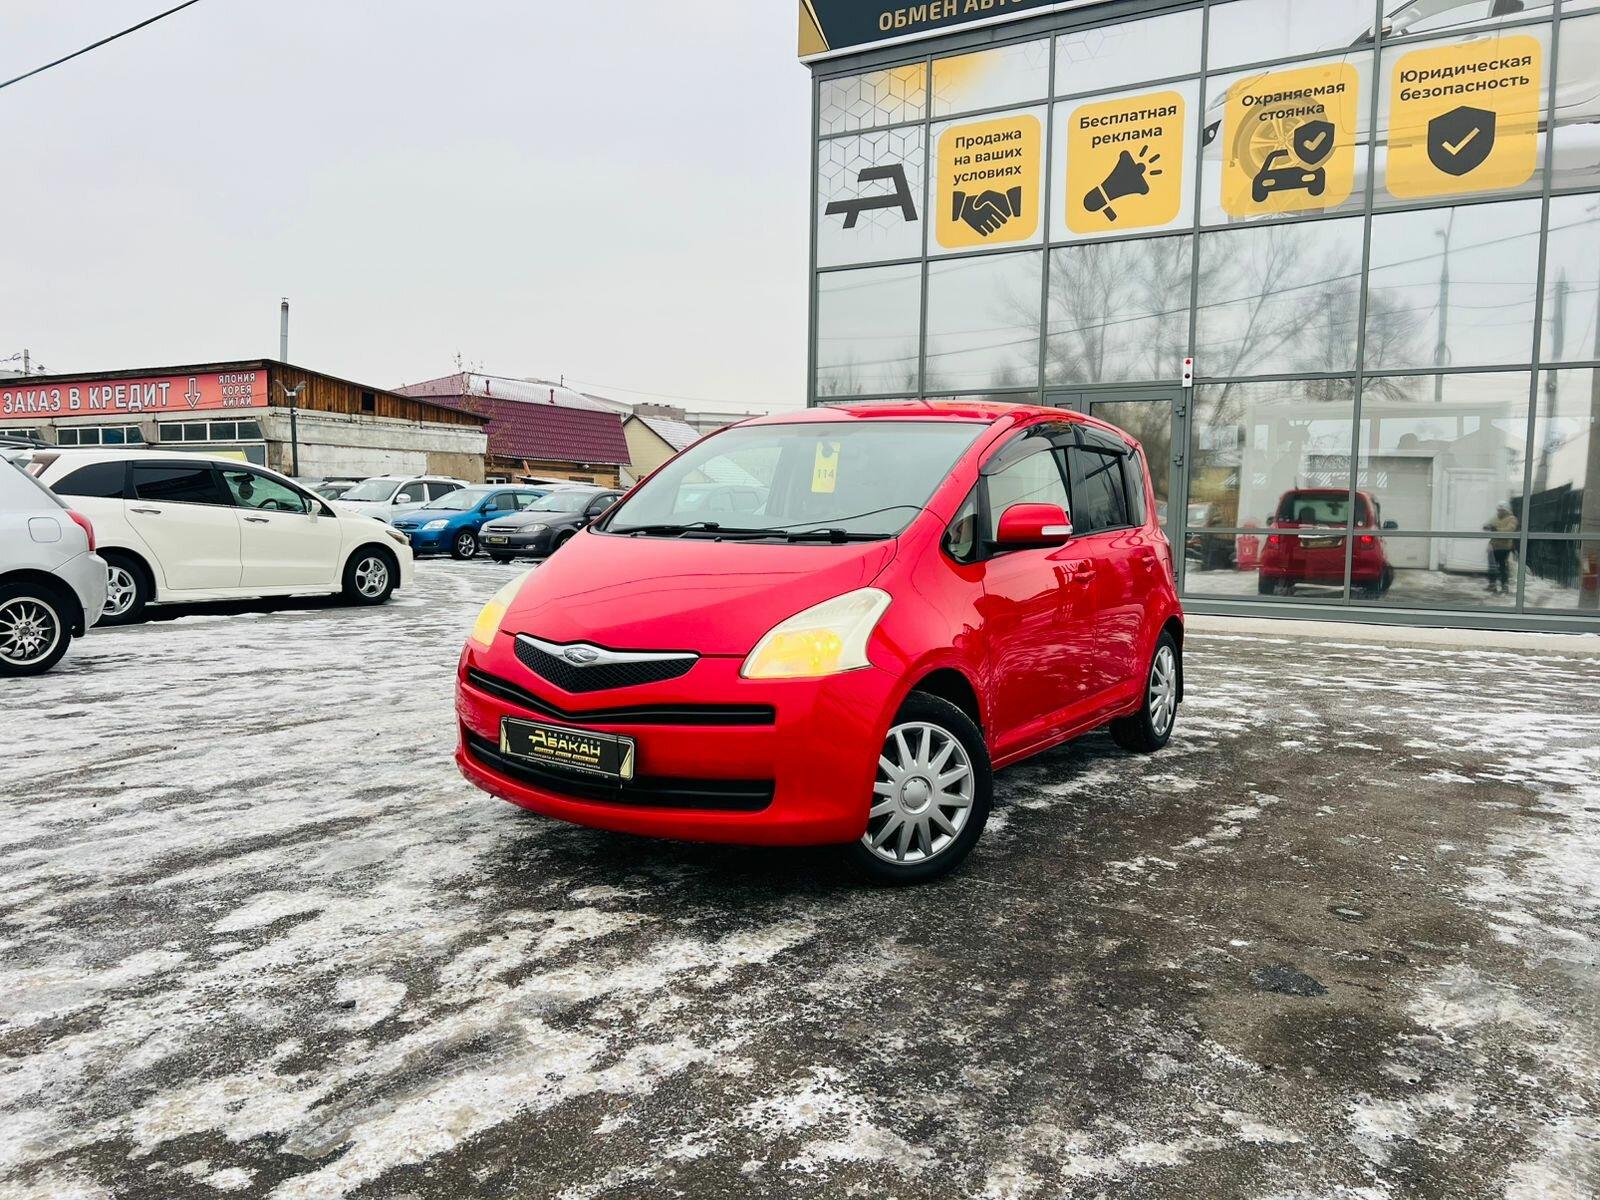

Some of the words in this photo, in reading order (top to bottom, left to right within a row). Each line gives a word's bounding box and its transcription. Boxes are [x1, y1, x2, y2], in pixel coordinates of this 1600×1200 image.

[879, 0, 958, 31] ОБМЕН
[1400, 55, 1532, 83] Юридическая
[1241, 82, 1346, 107] Охраняемая
[1400, 75, 1530, 101] безопасность
[1079, 104, 1177, 130] Бесплатная
[1258, 101, 1325, 122] стоянка
[955, 129, 1022, 149] Продажа
[1091, 124, 1163, 148] реклама
[953, 154, 972, 166] на
[975, 146, 1022, 163] ваших
[953, 164, 1022, 185] условиях
[218, 372, 256, 385] ЯПОНИЯ
[3, 389, 60, 414] ЗАКАЗ
[68, 388, 81, 410] В
[89, 382, 170, 412] КРЕДИТ
[221, 384, 252, 396] КОРЕЯ
[222, 394, 252, 407] КИТАЙ
